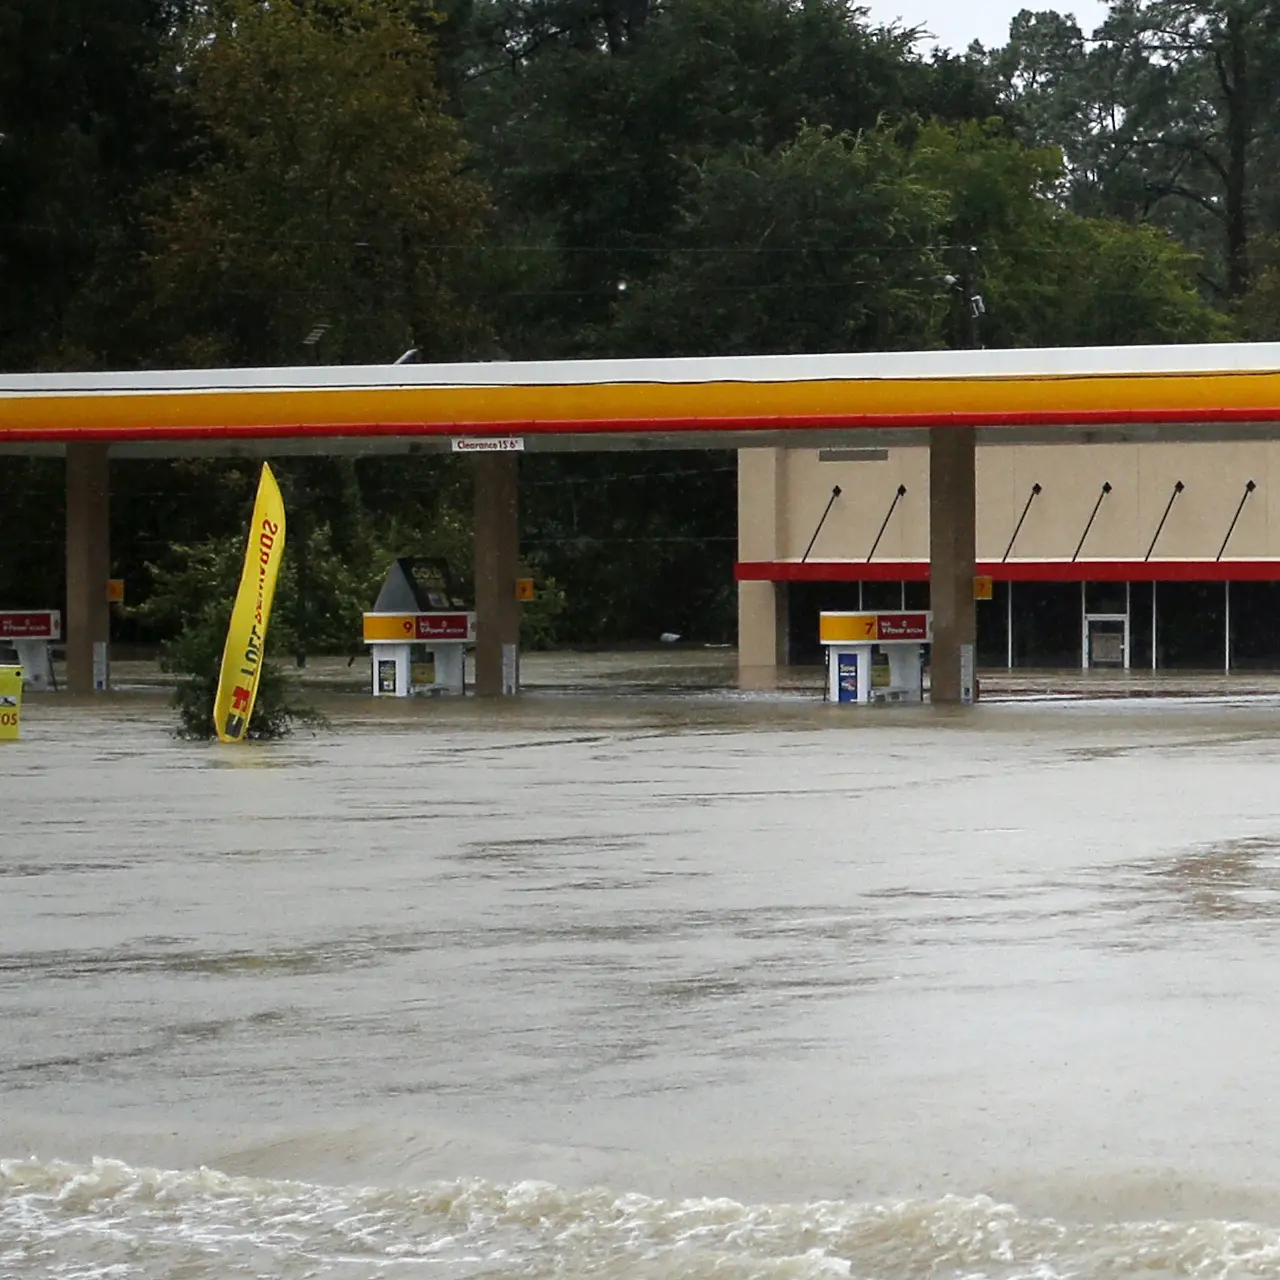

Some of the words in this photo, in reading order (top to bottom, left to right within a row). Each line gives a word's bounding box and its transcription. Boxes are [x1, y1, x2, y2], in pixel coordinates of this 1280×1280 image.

[457, 440, 498, 450] Clearance
[403, 621, 413, 634] 9
[865, 622, 874, 636] 7
